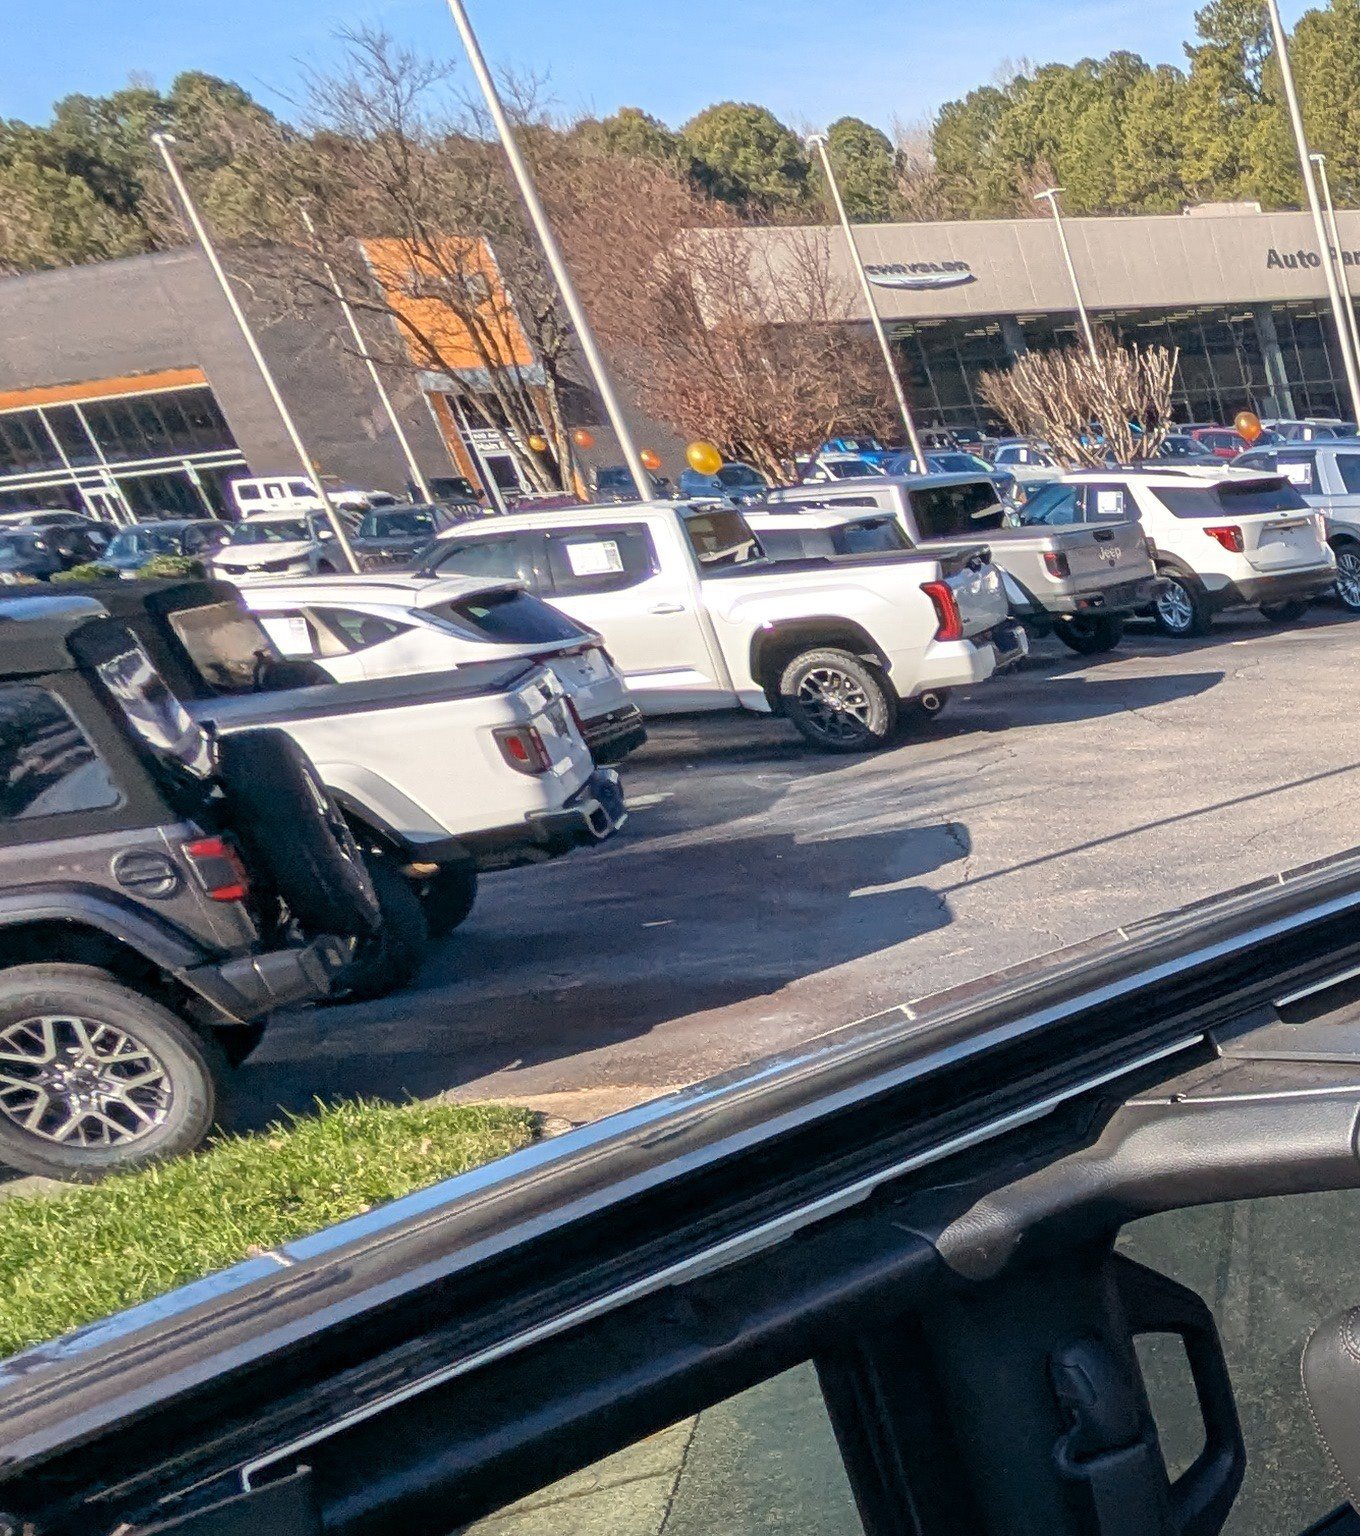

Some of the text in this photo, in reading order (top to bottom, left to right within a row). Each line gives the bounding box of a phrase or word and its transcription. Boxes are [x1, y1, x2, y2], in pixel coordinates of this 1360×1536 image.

[1266, 248, 1321, 270] Auto
[864, 261, 972, 276] CHRYSLER
[1099, 547, 1122, 560] Jeep
